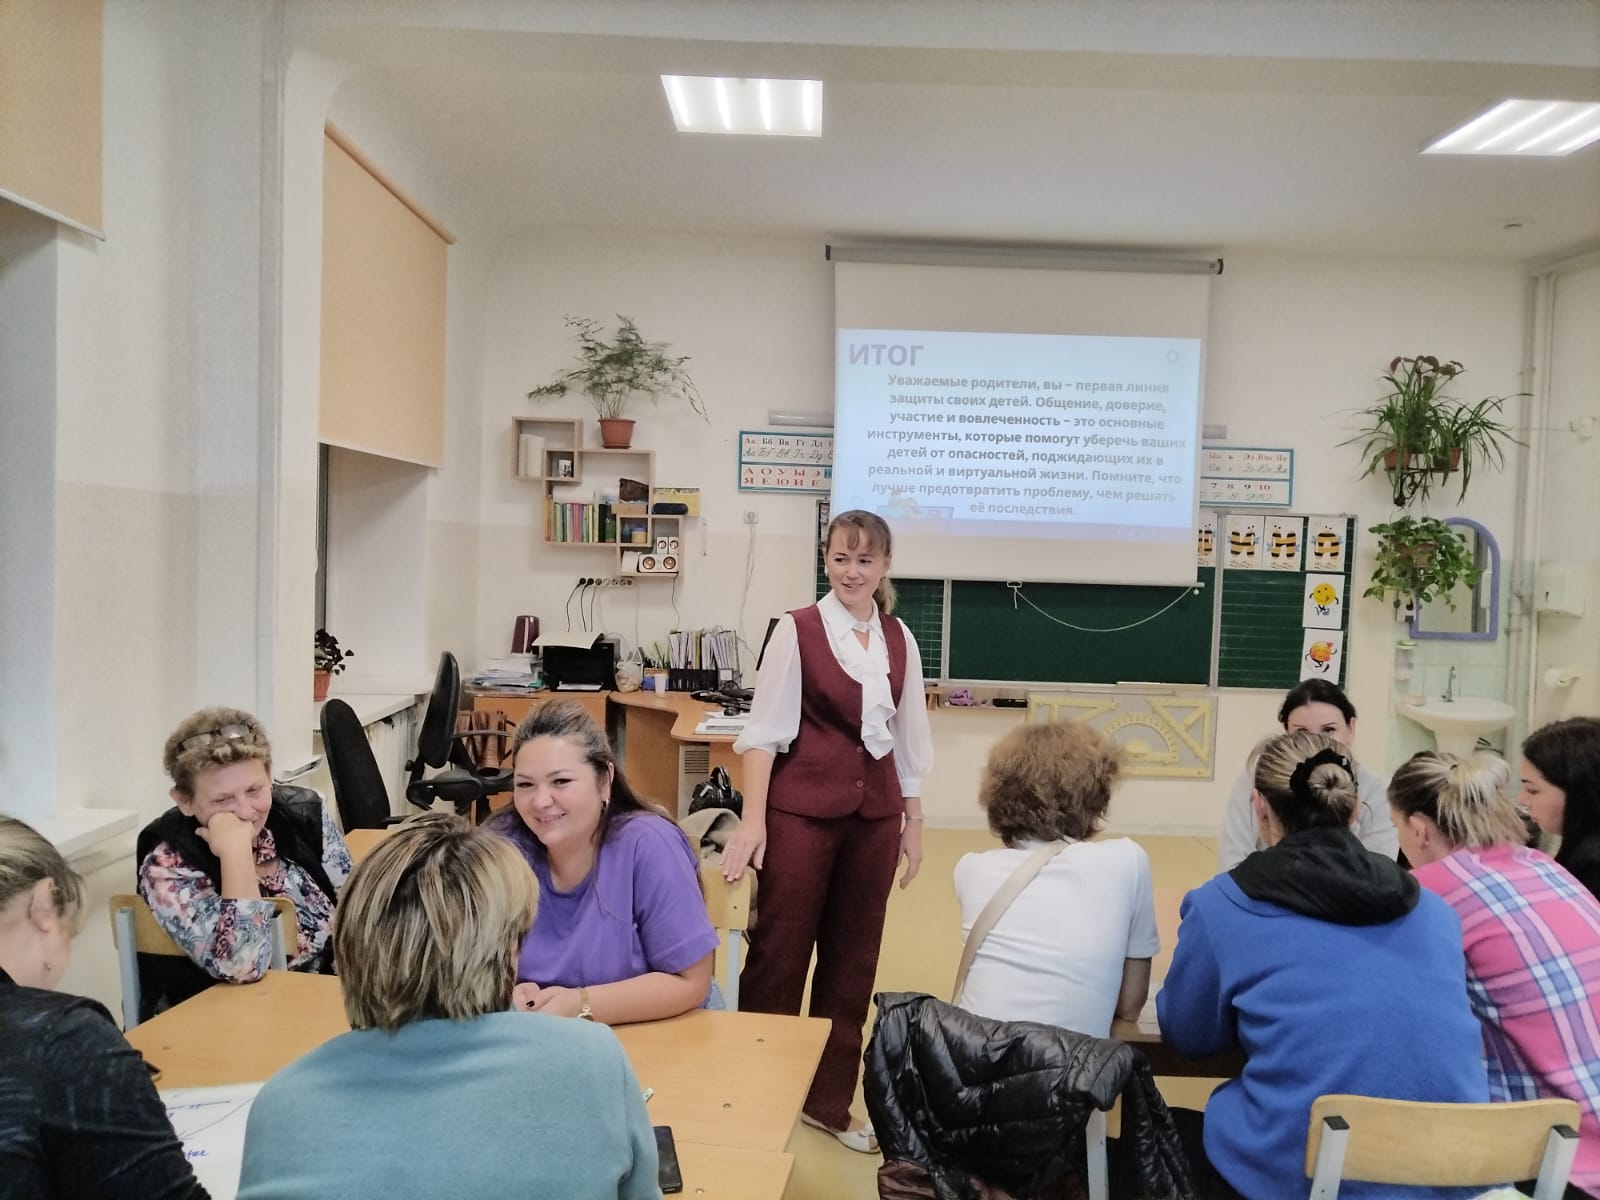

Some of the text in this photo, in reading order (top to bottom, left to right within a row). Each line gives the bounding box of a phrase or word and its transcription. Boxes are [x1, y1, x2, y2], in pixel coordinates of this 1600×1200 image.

[849, 343, 925, 366] ИТОГ
[888, 375, 969, 388] Уважаемые
[971, 378, 1040, 391] родители,
[1043, 381, 1062, 391] вы
[1075, 382, 1123, 393] первая
[1126, 383, 1169, 393] линия
[890, 394, 1167, 413] защиты своих детей. Общение, доверие,
[890, 412, 944, 425] участие
[947, 413, 956, 423] и
[959, 414, 1061, 426] вовлеченность
[1074, 417, 1096, 427] это
[1098, 418, 1165, 429] основные
[867, 429, 1186, 448] инструменты, которые помогут уберечь ваших
[887, 446, 1164, 466] детей от опасностей, поджидающих их в
[868, 464, 1182, 485] реальной и виртуальной жизни. Помните, что
[872, 484, 1176, 502] лучше предотвратить проблему, чем решать
[970, 503, 1075, 517] её последствия.
